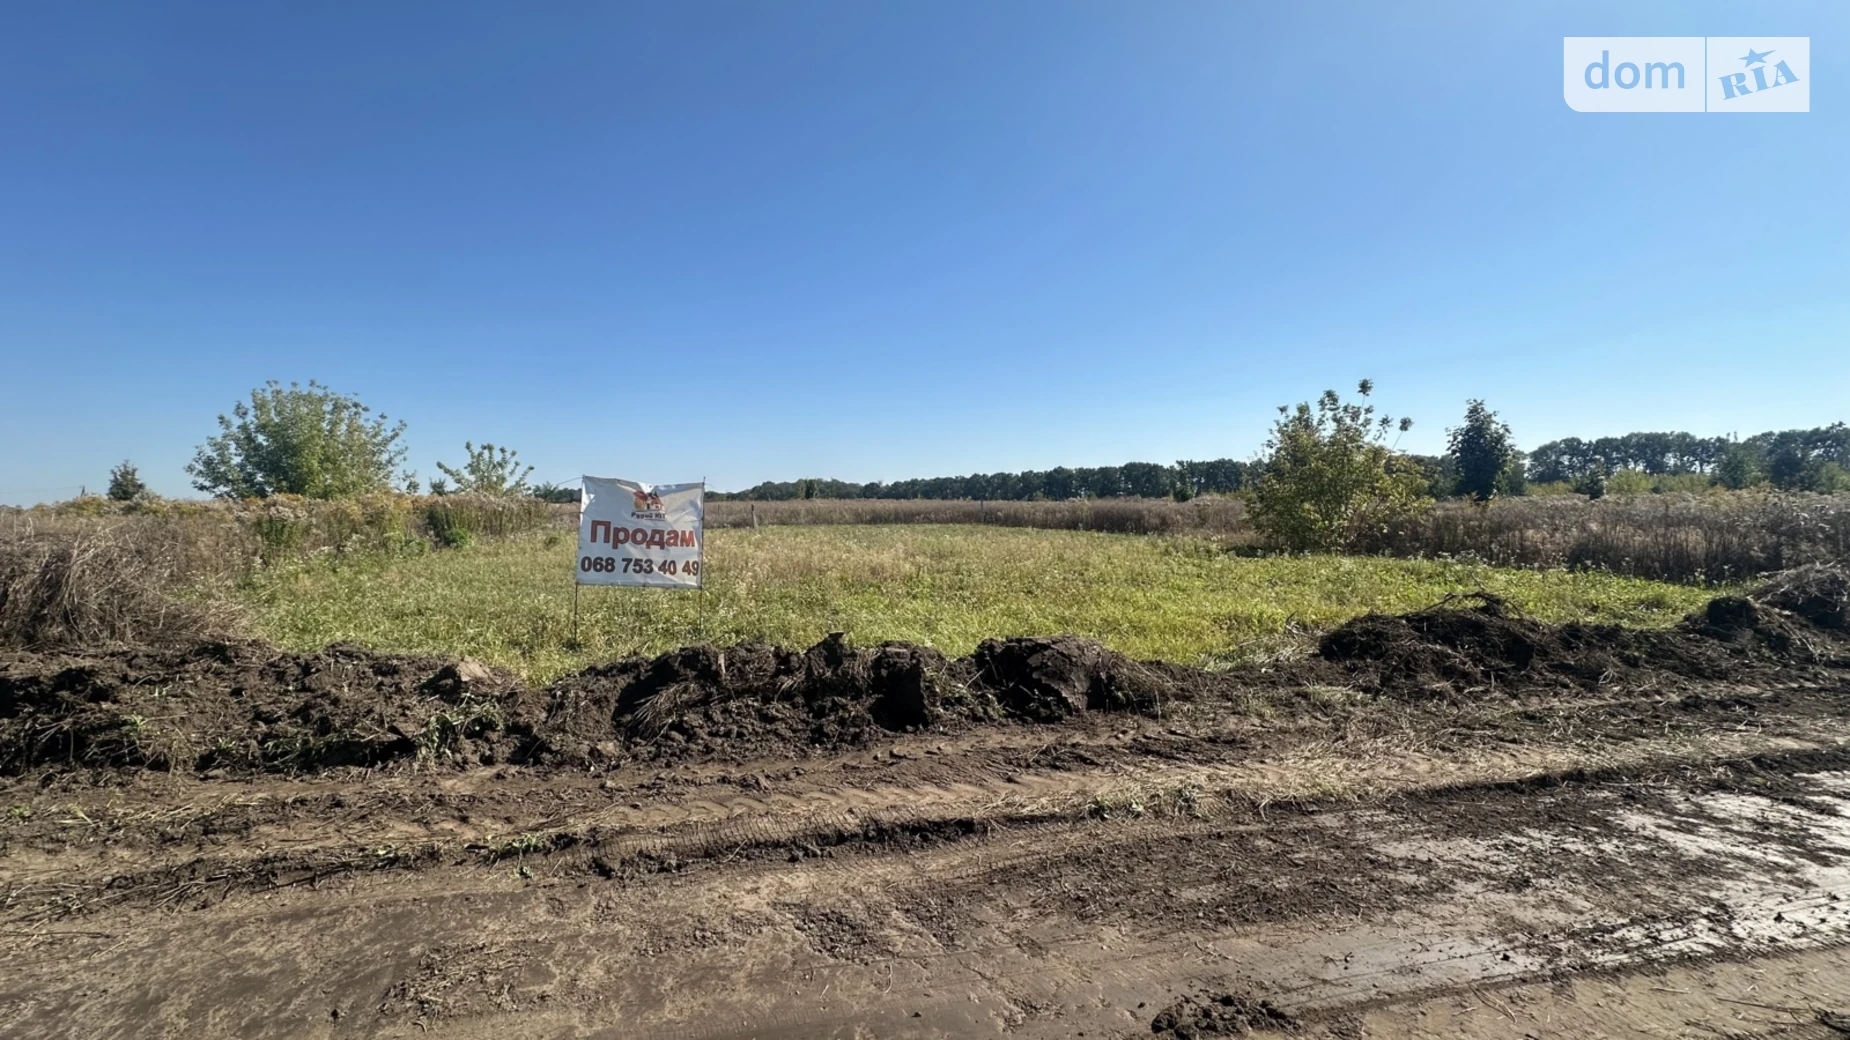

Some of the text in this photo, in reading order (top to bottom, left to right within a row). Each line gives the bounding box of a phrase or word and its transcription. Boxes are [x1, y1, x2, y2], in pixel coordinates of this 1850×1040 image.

[590, 520, 695, 550] Продам
[581, 556, 700, 577] 068 753 40 49
